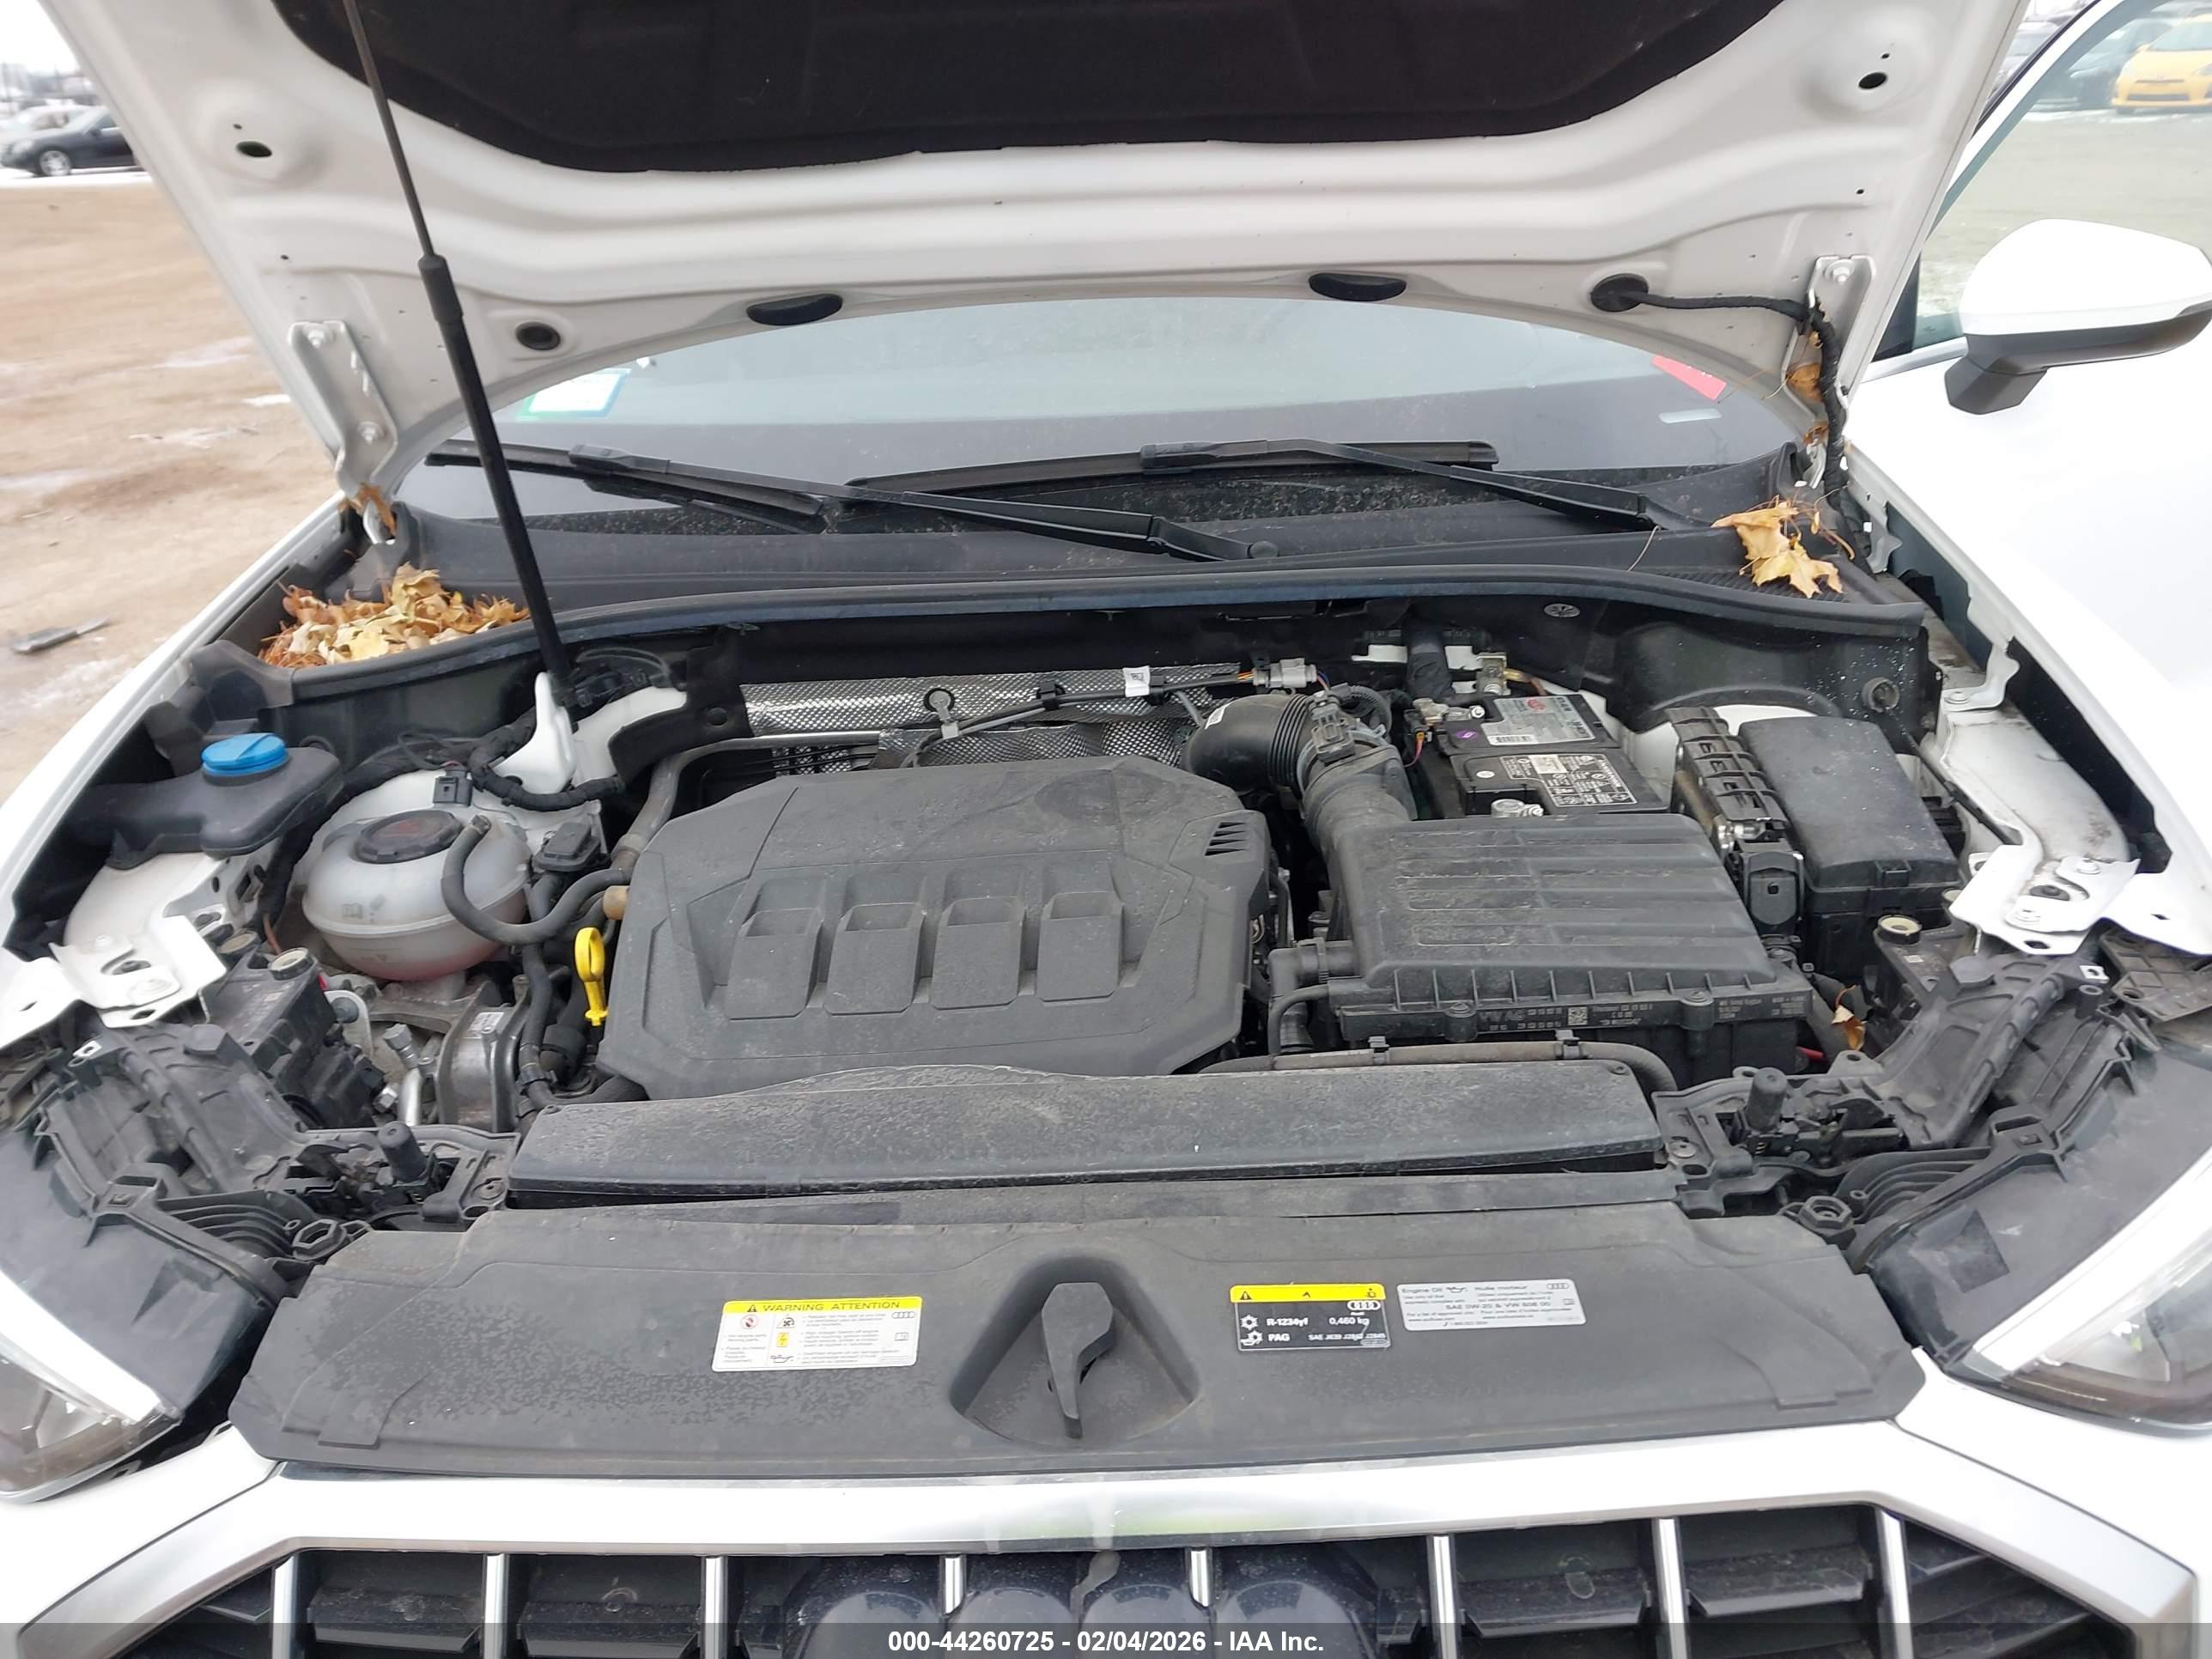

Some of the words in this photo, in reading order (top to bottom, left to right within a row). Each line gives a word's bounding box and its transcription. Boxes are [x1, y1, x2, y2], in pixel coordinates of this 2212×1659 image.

[763, 1304, 824, 1312] WARNING
[830, 1301, 901, 1310] ATTENTION
[1267, 1317, 1309, 1328] R-1234yf
[1267, 1333, 1291, 1342] PAG
